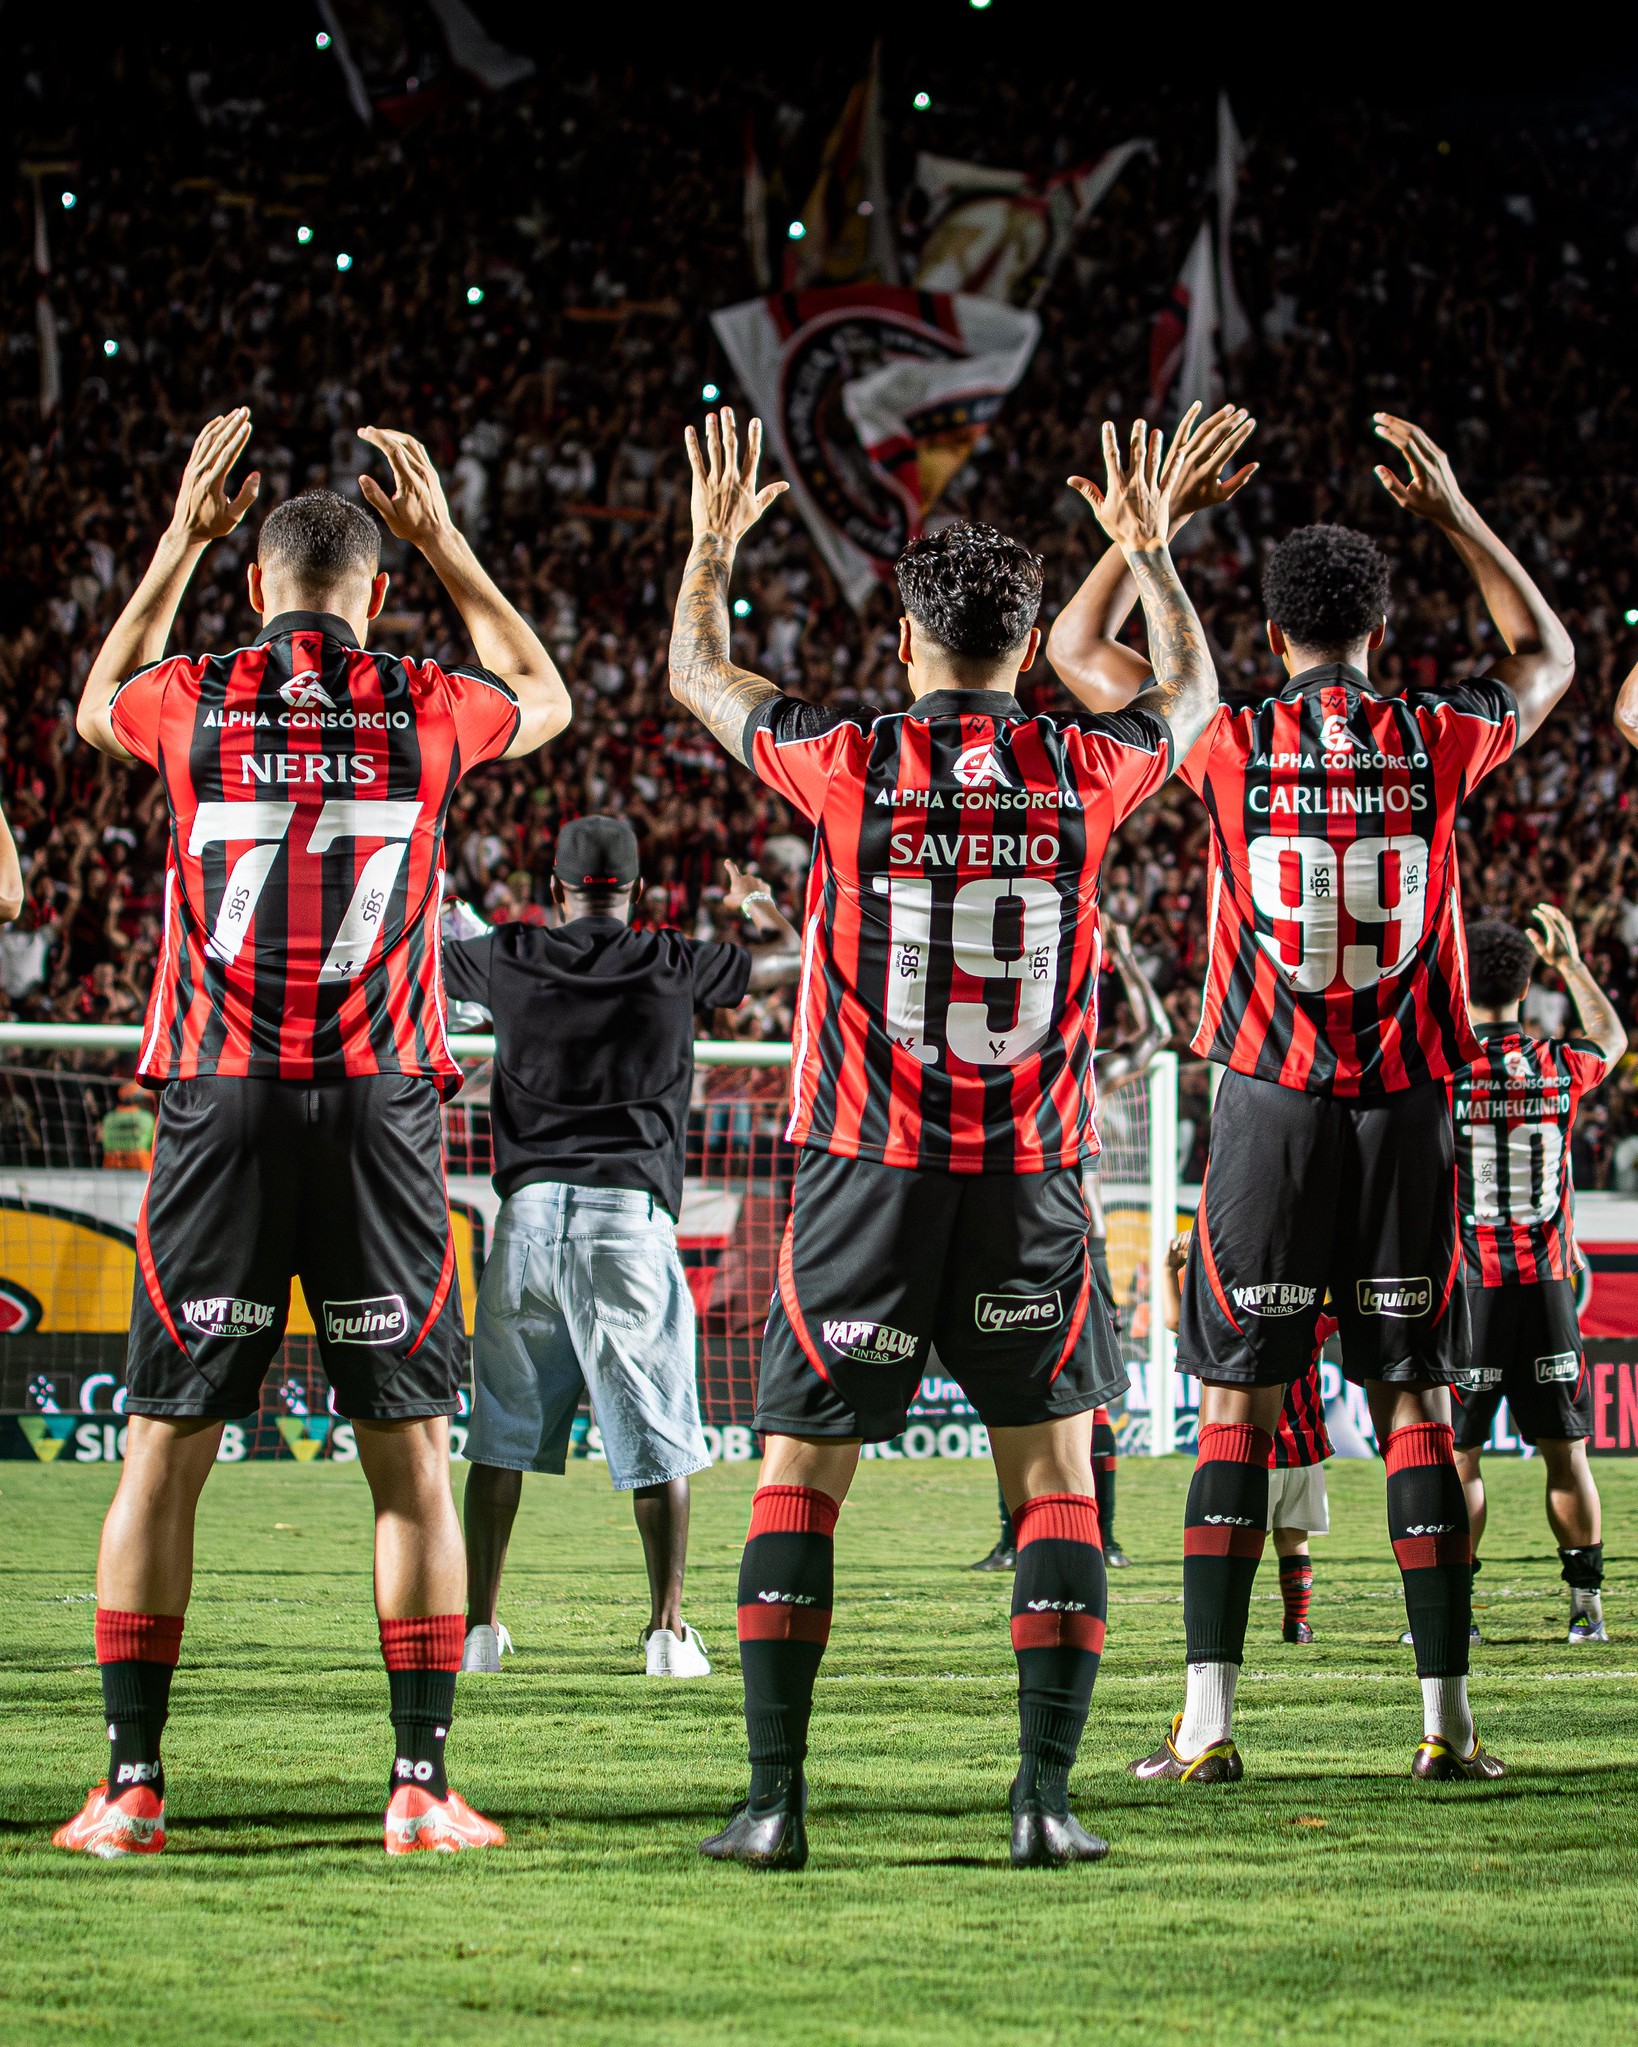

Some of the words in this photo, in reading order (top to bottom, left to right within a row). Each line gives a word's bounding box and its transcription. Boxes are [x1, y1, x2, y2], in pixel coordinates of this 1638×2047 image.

[203, 709, 271, 727] ALPHA
[277, 709, 410, 729] CONSÓRCIO
[240, 754, 376, 785] NERIS
[1256, 752, 1315, 769] ALPHA
[1321, 751, 1428, 769] CONSÓRCIO
[874, 788, 944, 808] ALPHA
[952, 789, 1078, 809] CONSÓRCIO
[1250, 784, 1428, 814] CARLINHOS
[890, 834, 1060, 866] SAVERIO
[188, 801, 424, 982] 77
[1315, 868, 1329, 897] SBS
[1407, 865, 1418, 895] SBS
[228, 886, 250, 922] SBS
[363, 889, 384, 925] SBS
[1248, 835, 1429, 992] 99
[872, 878, 1062, 1065] 19
[901, 944, 920, 978] SBS
[1034, 946, 1050, 980] SBS
[1461, 1080, 1500, 1090] ALPHA
[1456, 1094, 1570, 1119] MATHEUZINHO
[1462, 1122, 1563, 1225] 10
[1232, 1286, 1276, 1307] VAPT
[1280, 1286, 1317, 1305] BLUE
[1261, 1305, 1293, 1314] TINTAS
[1363, 1288, 1427, 1313] Iquine
[182, 1300, 227, 1323] VAPT
[231, 1301, 275, 1327] BLUE
[328, 1309, 401, 1340] Iquine
[980, 1302, 1055, 1330] Iquine
[211, 1323, 248, 1334] TINTAS
[822, 1320, 873, 1347] VAPT
[875, 1327, 919, 1358] BLUE
[851, 1347, 889, 1362] TINTAS
[117, 1760, 159, 1783] PRO
[395, 1758, 433, 1781] RO
